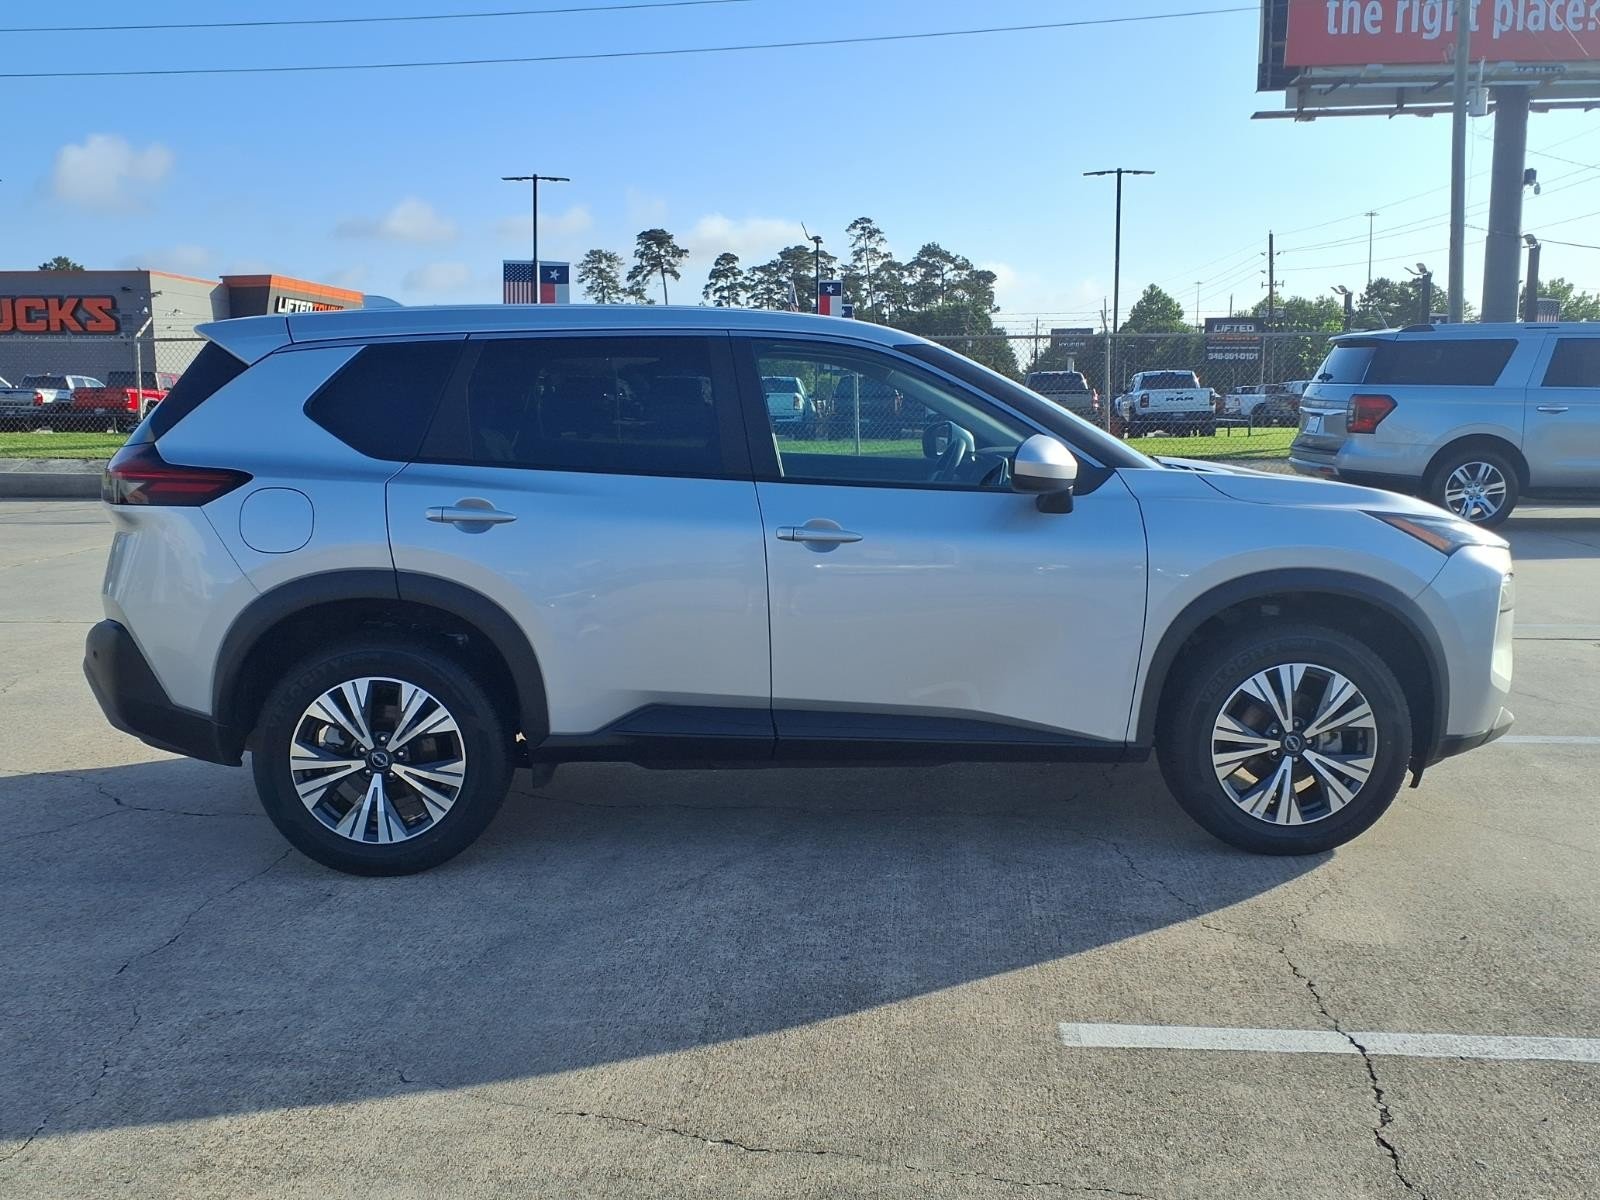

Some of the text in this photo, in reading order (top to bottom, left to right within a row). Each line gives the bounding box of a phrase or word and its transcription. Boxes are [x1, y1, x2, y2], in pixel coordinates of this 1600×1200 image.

[1326, 0, 1383, 34] the
[278, 297, 314, 313] LIFTED
[1213, 324, 1255, 333] LIFTED
